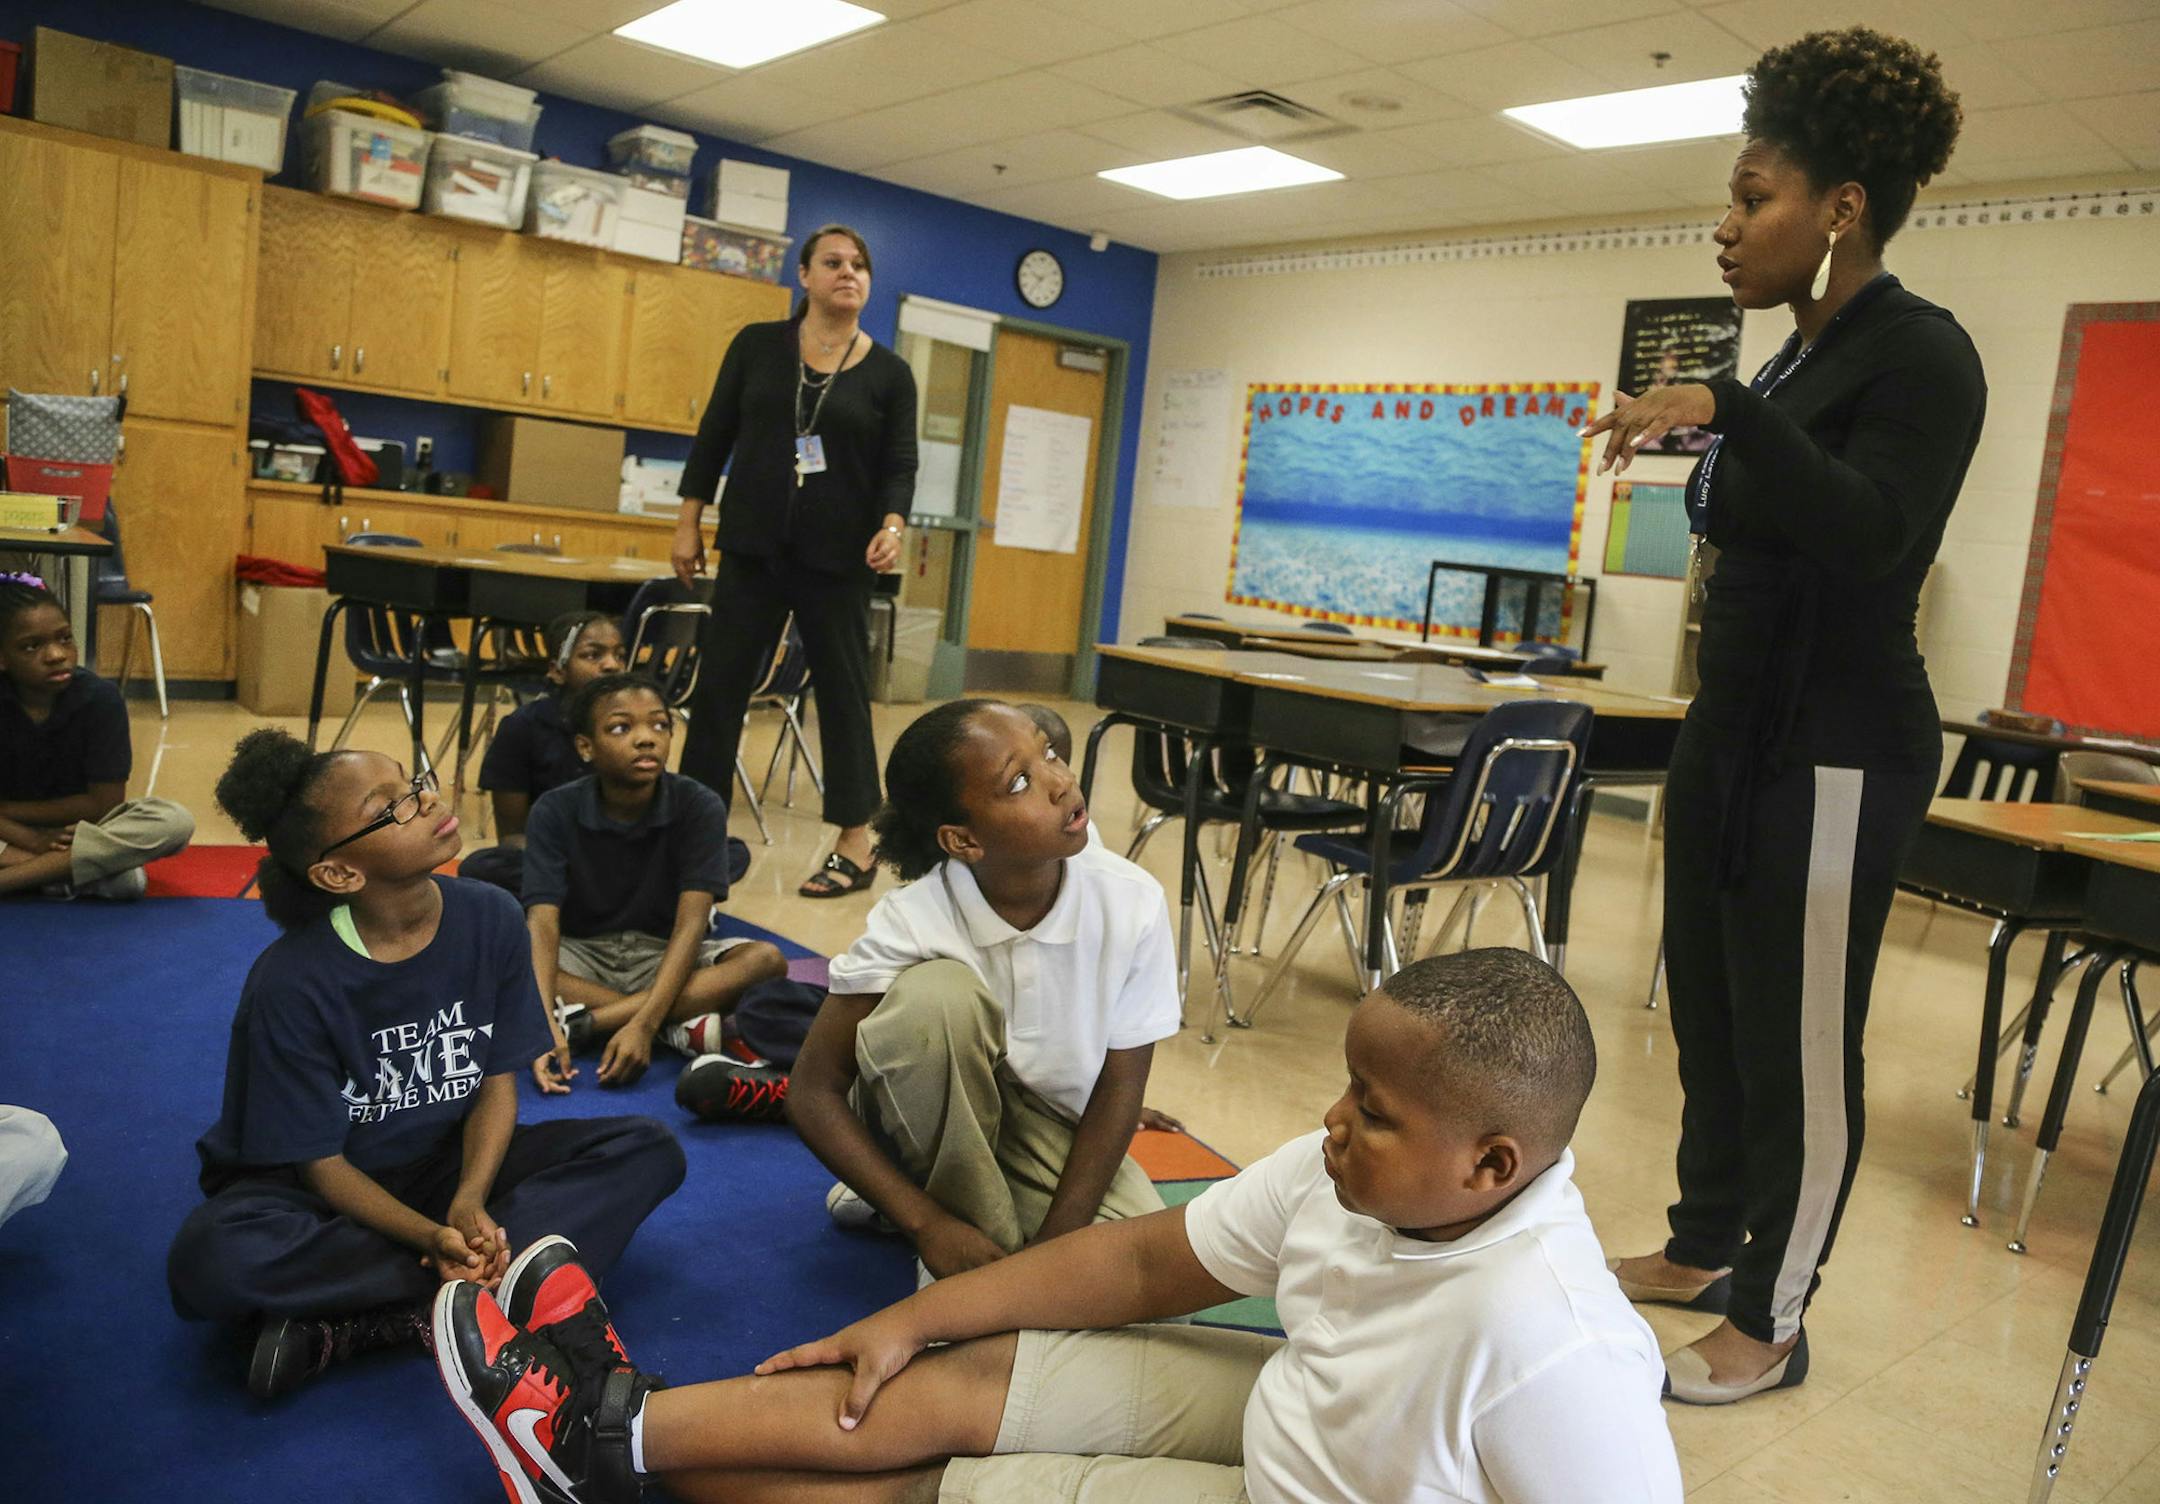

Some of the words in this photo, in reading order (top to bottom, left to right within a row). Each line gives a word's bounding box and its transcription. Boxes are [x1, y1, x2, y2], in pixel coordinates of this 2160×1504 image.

[1258, 397, 1344, 424] HOPES
[1371, 400, 1434, 420] AND
[1459, 396, 1585, 428] DREAMS
[1697, 481, 1711, 508] Lucy
[371, 1001, 467, 1054] TEAM
[341, 1023, 494, 1105] LANE
